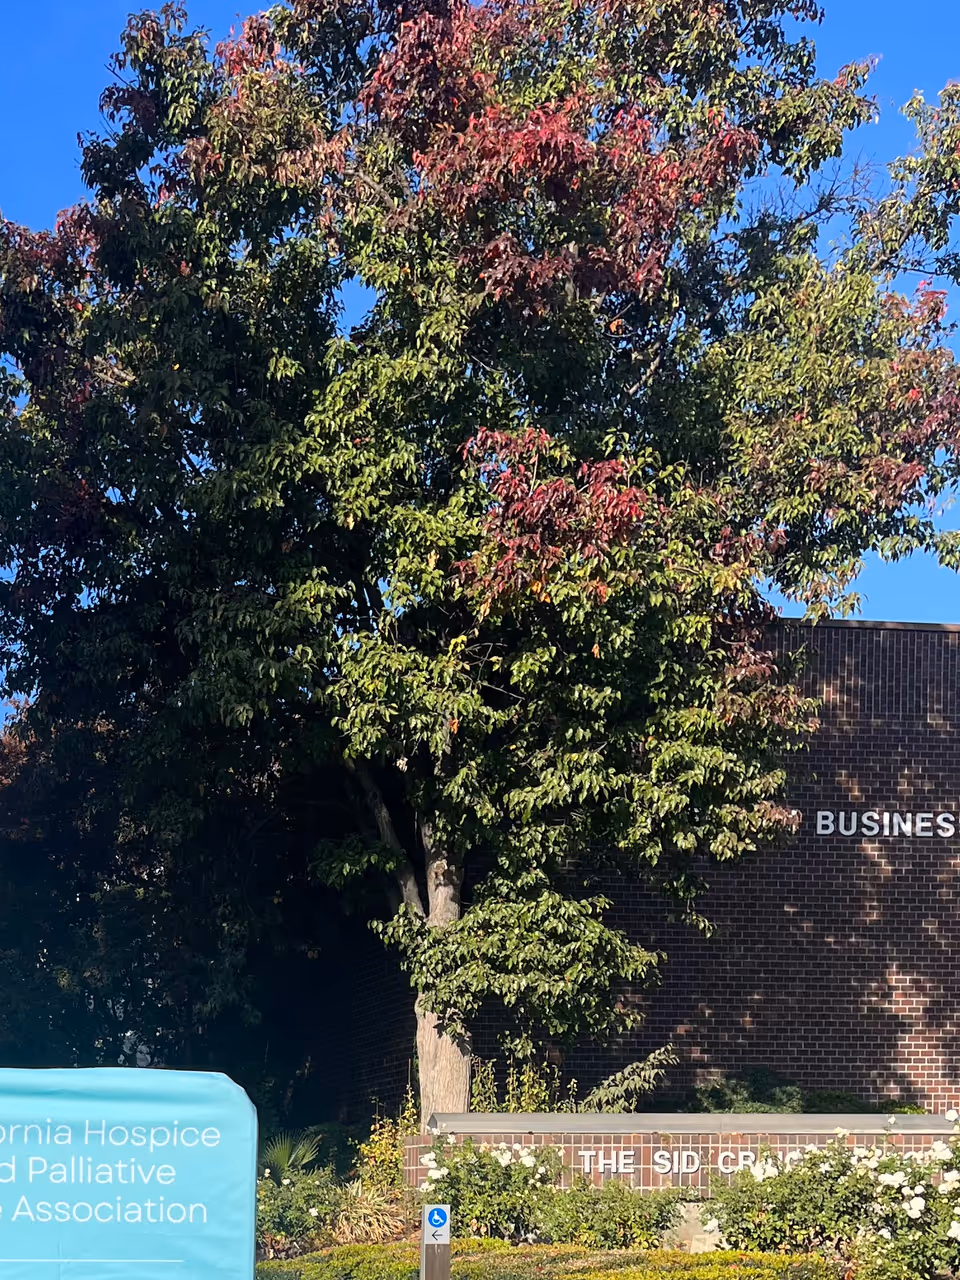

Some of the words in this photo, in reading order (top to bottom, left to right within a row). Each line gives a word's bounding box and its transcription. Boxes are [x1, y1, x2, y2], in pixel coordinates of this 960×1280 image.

[816, 810, 960, 838] BUSINES
[84, 1119, 221, 1153] Hospice
[28, 1157, 176, 1185] Palliative
[578, 1150, 636, 1174] THE
[653, 1150, 700, 1175] SID
[12, 1195, 208, 1224] Association
